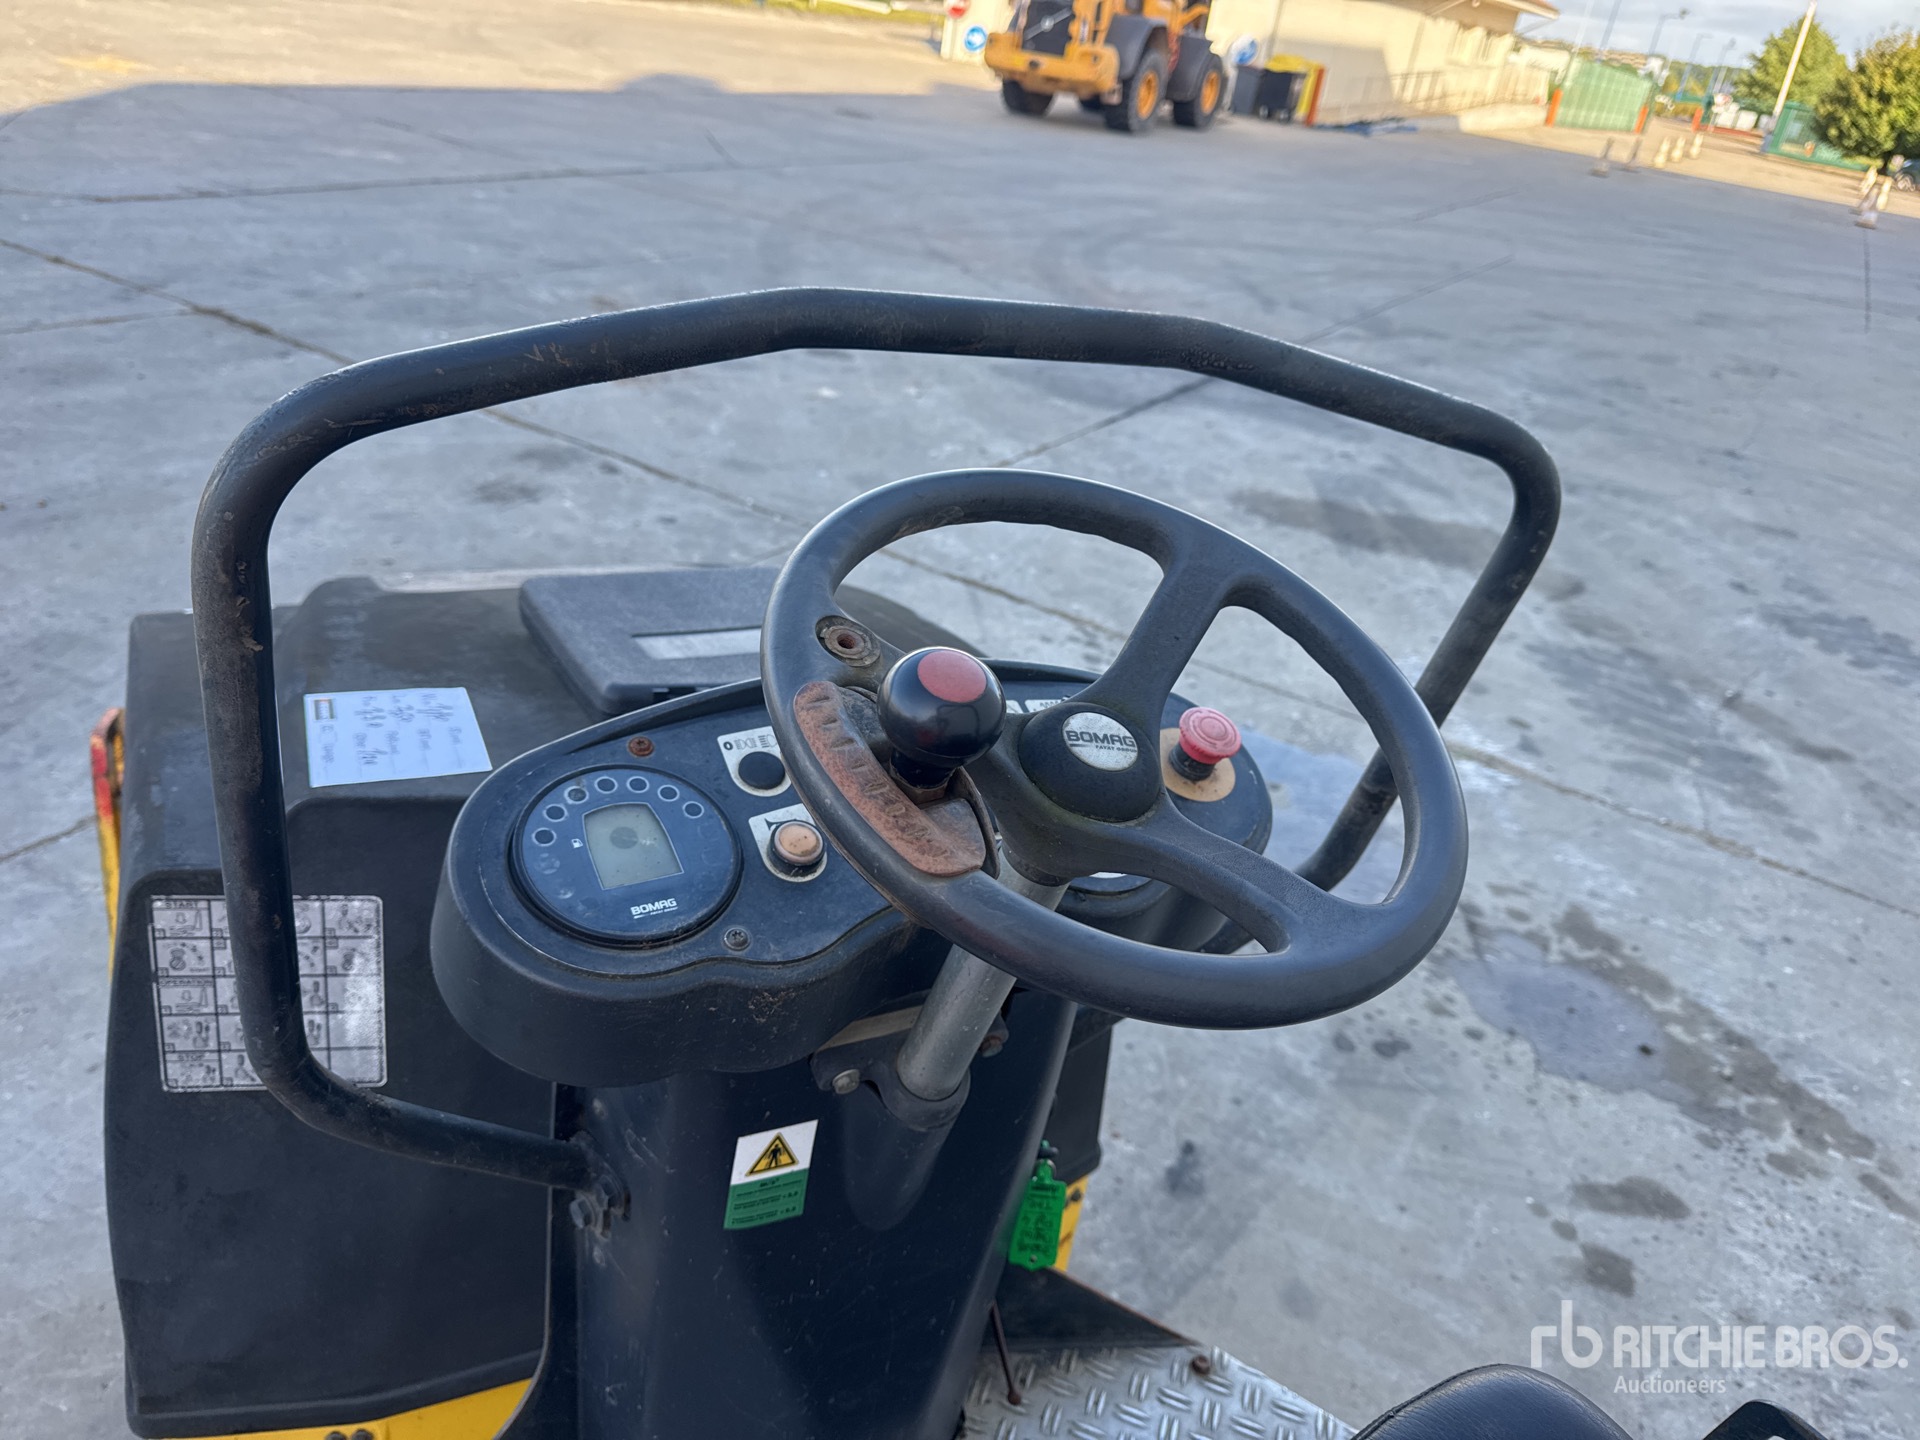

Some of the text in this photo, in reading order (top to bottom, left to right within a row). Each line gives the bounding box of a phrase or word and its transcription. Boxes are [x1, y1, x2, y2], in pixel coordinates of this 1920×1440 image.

[1065, 730, 1136, 748] BOMAG
[165, 901, 199, 909] START
[630, 898, 677, 915] BOMAG
[178, 1053, 204, 1061] STOP
